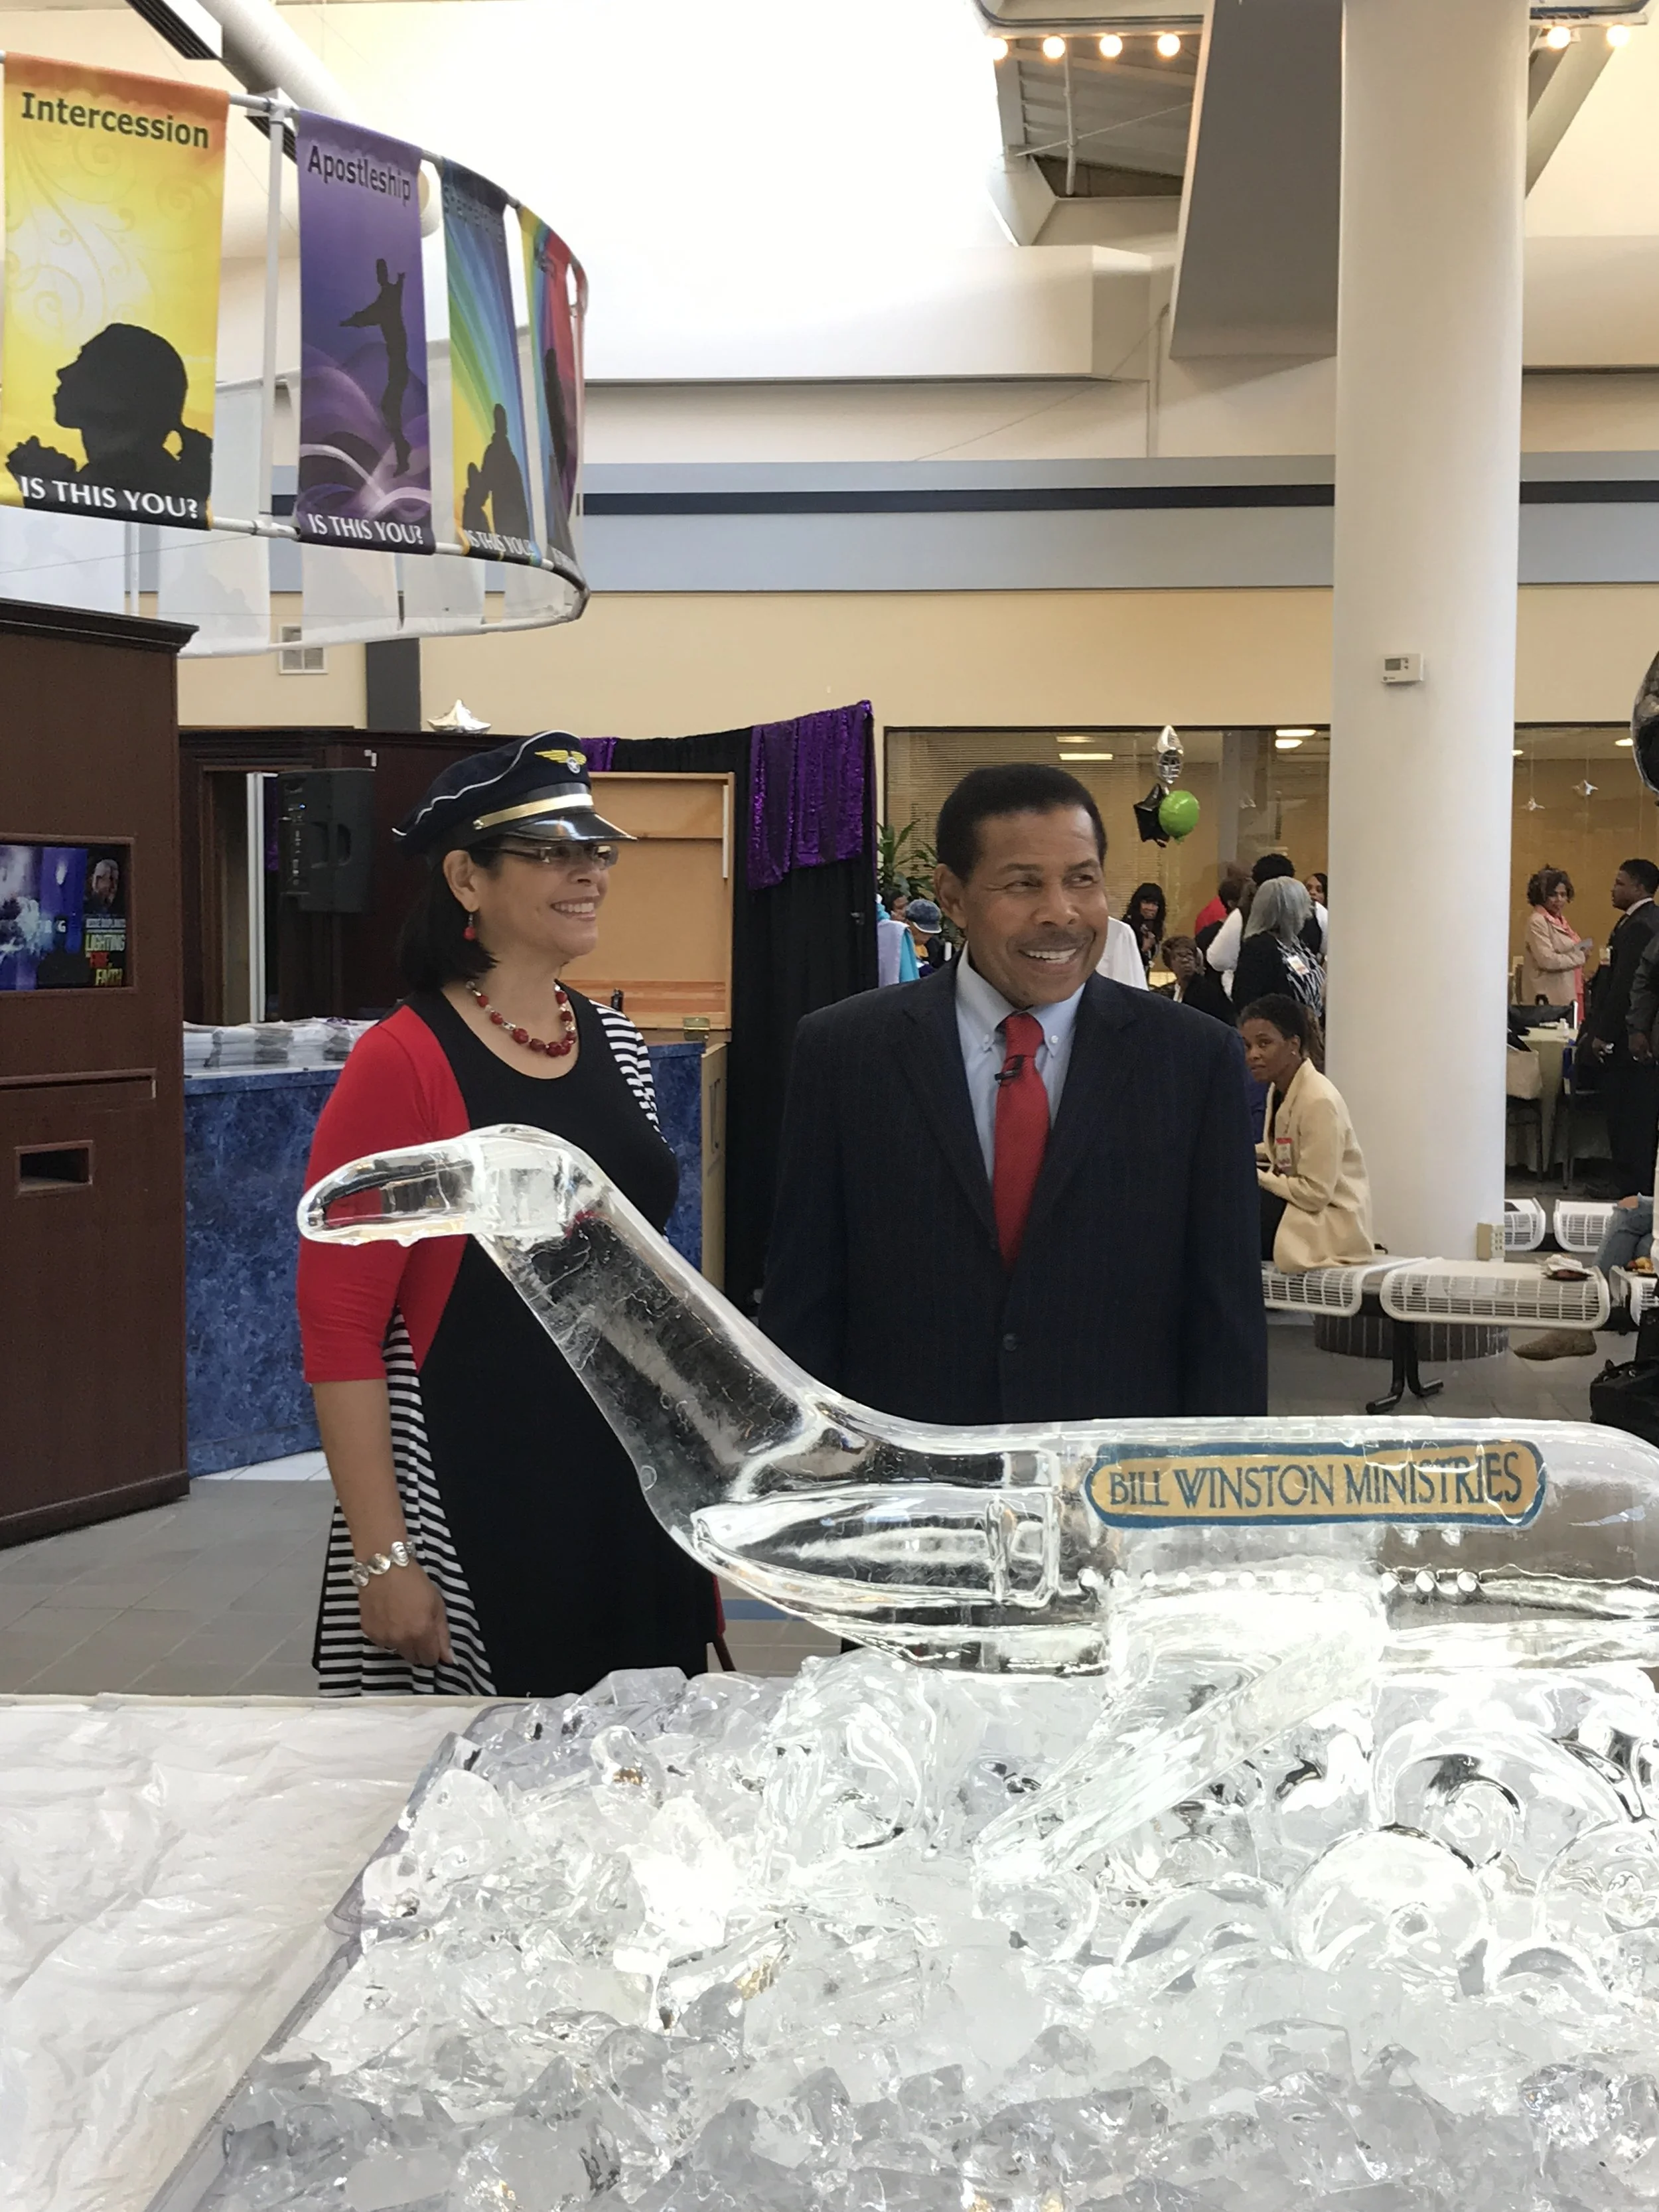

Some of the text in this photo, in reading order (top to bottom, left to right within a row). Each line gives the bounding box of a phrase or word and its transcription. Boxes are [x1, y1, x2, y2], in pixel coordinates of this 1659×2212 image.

[21, 91, 209, 149] Intercession
[307, 145, 411, 208] Apostleship
[20, 475, 198, 519] IS THIS YOU?
[307, 513, 423, 545] IS THIS YOU?
[476, 532, 506, 553] THIS
[1110, 1451, 1522, 1510] BILL WINSTON MINISTRIES
